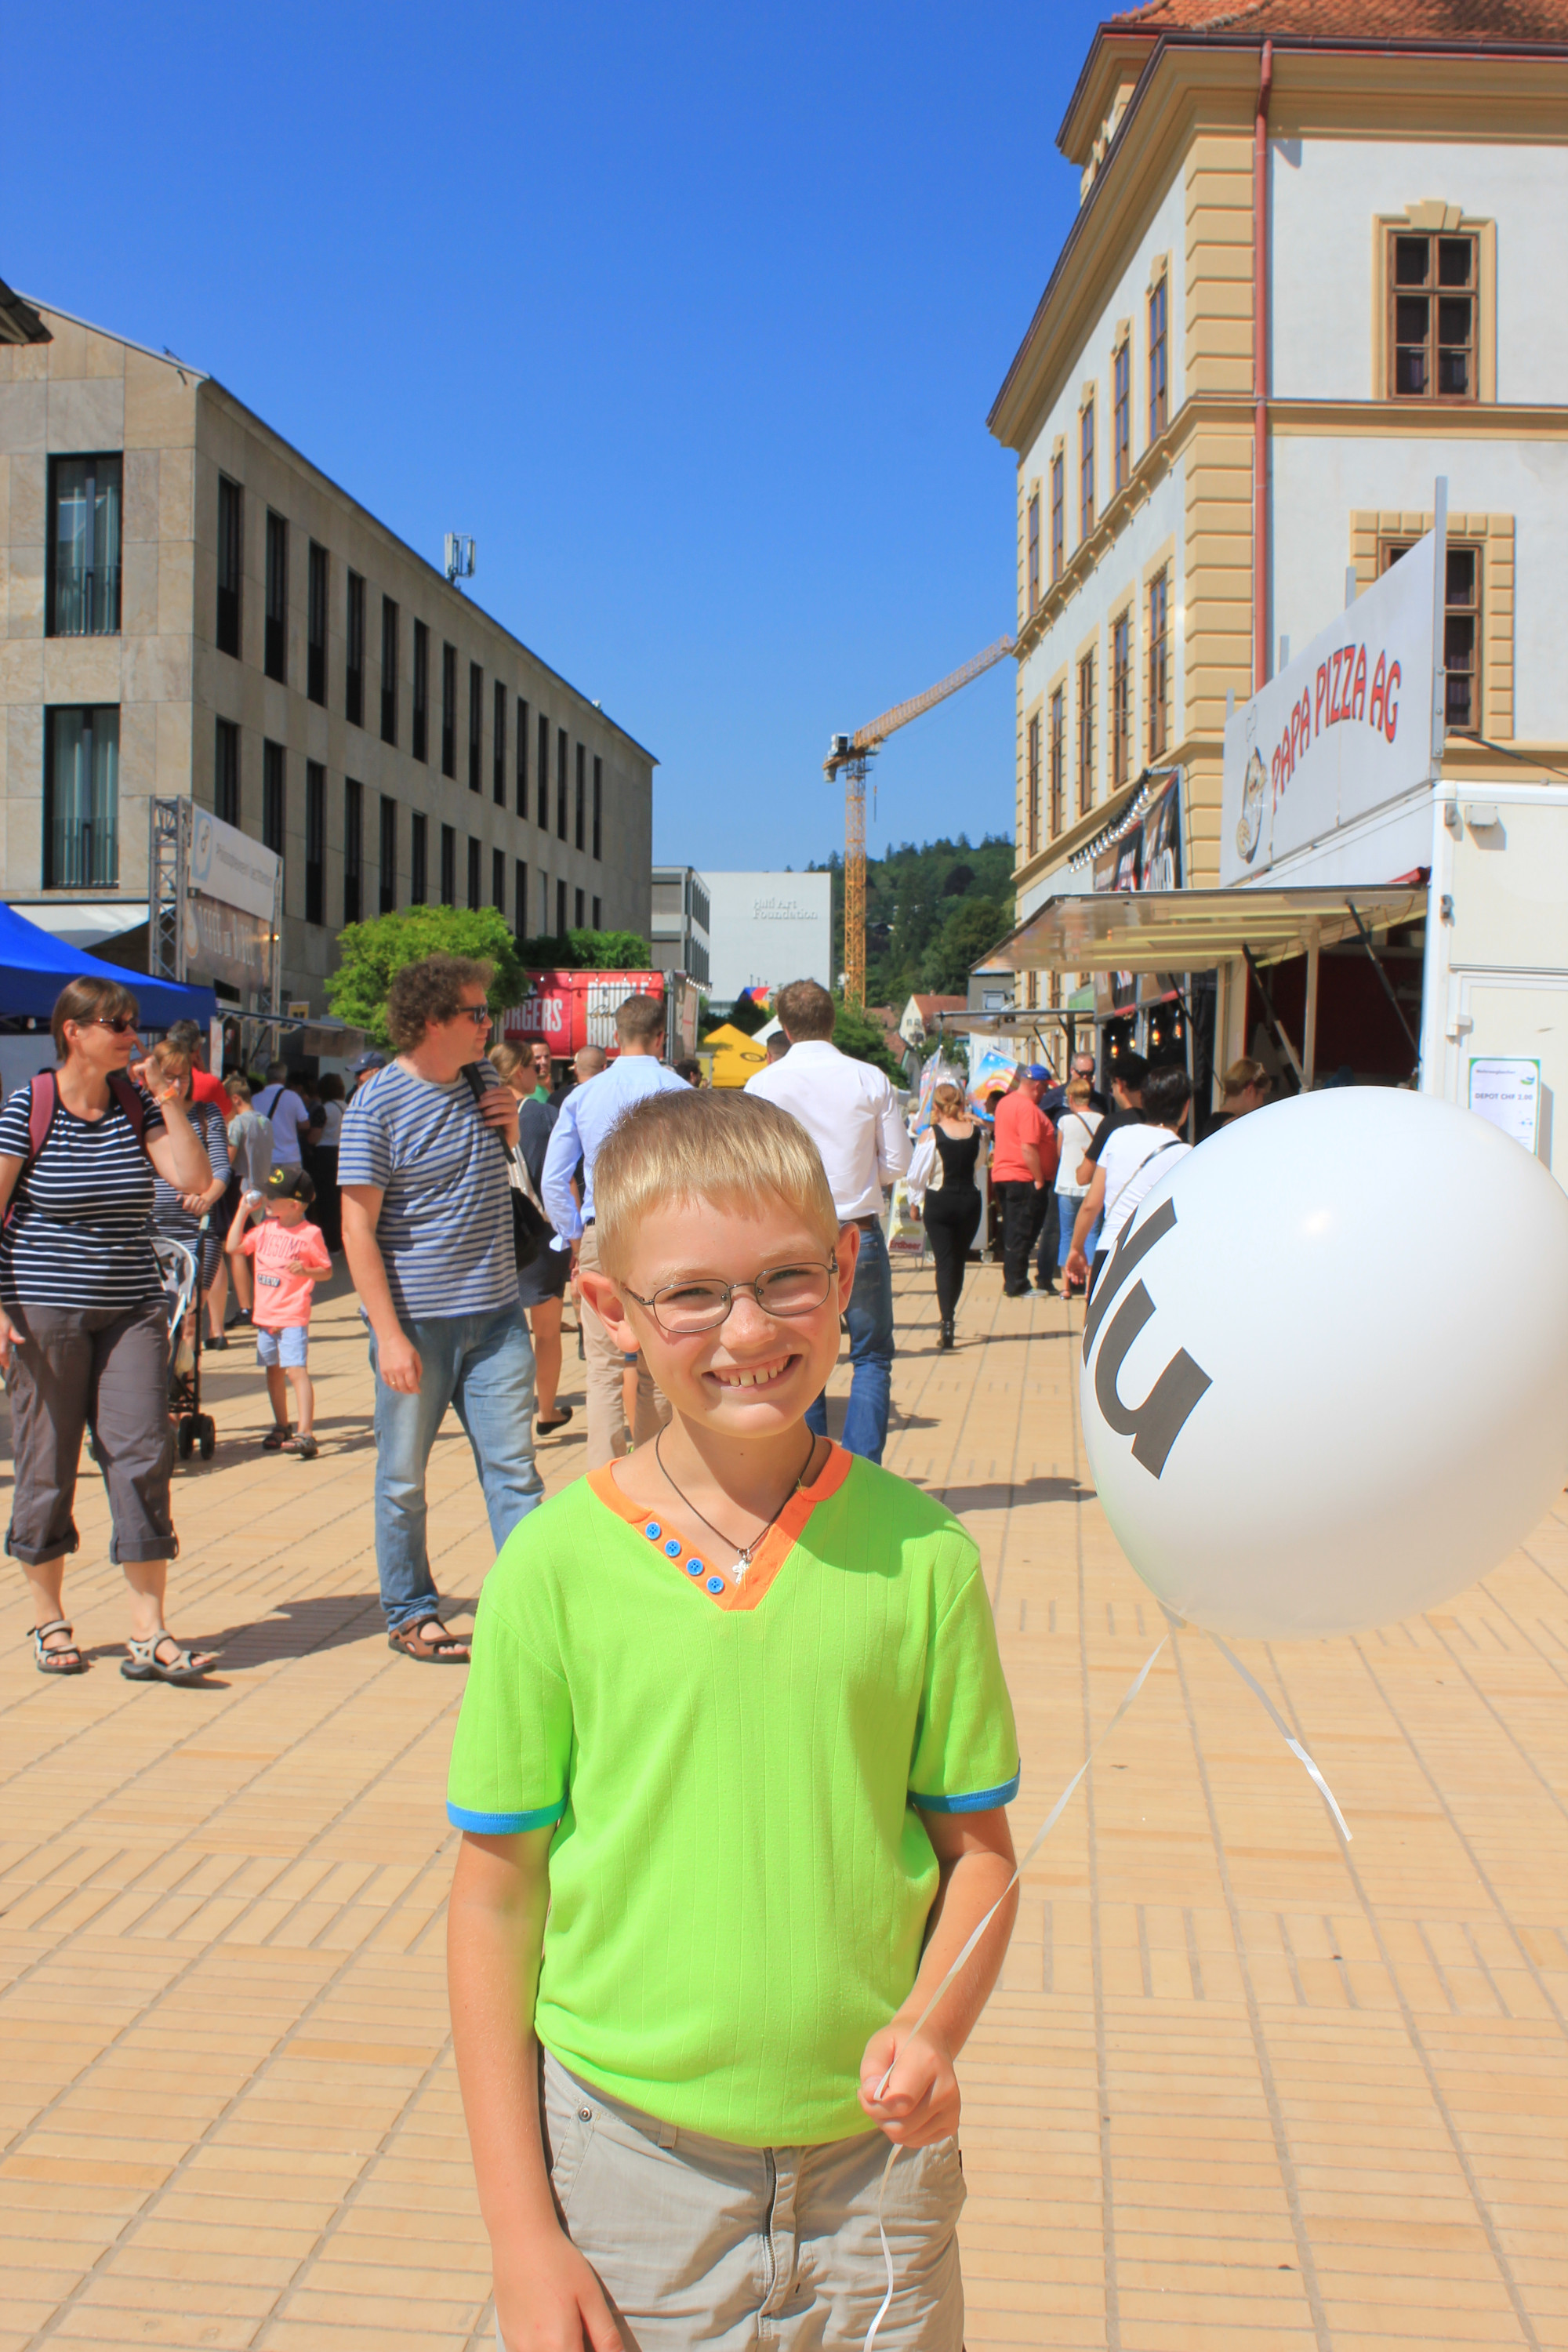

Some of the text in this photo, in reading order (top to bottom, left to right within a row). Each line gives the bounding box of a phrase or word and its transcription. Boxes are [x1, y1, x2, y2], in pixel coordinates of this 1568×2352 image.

[1271, 642, 1402, 815] PAPA PIZZA AG
[753, 909, 818, 920] Foundation
[259, 1275, 279, 1287] CREW
